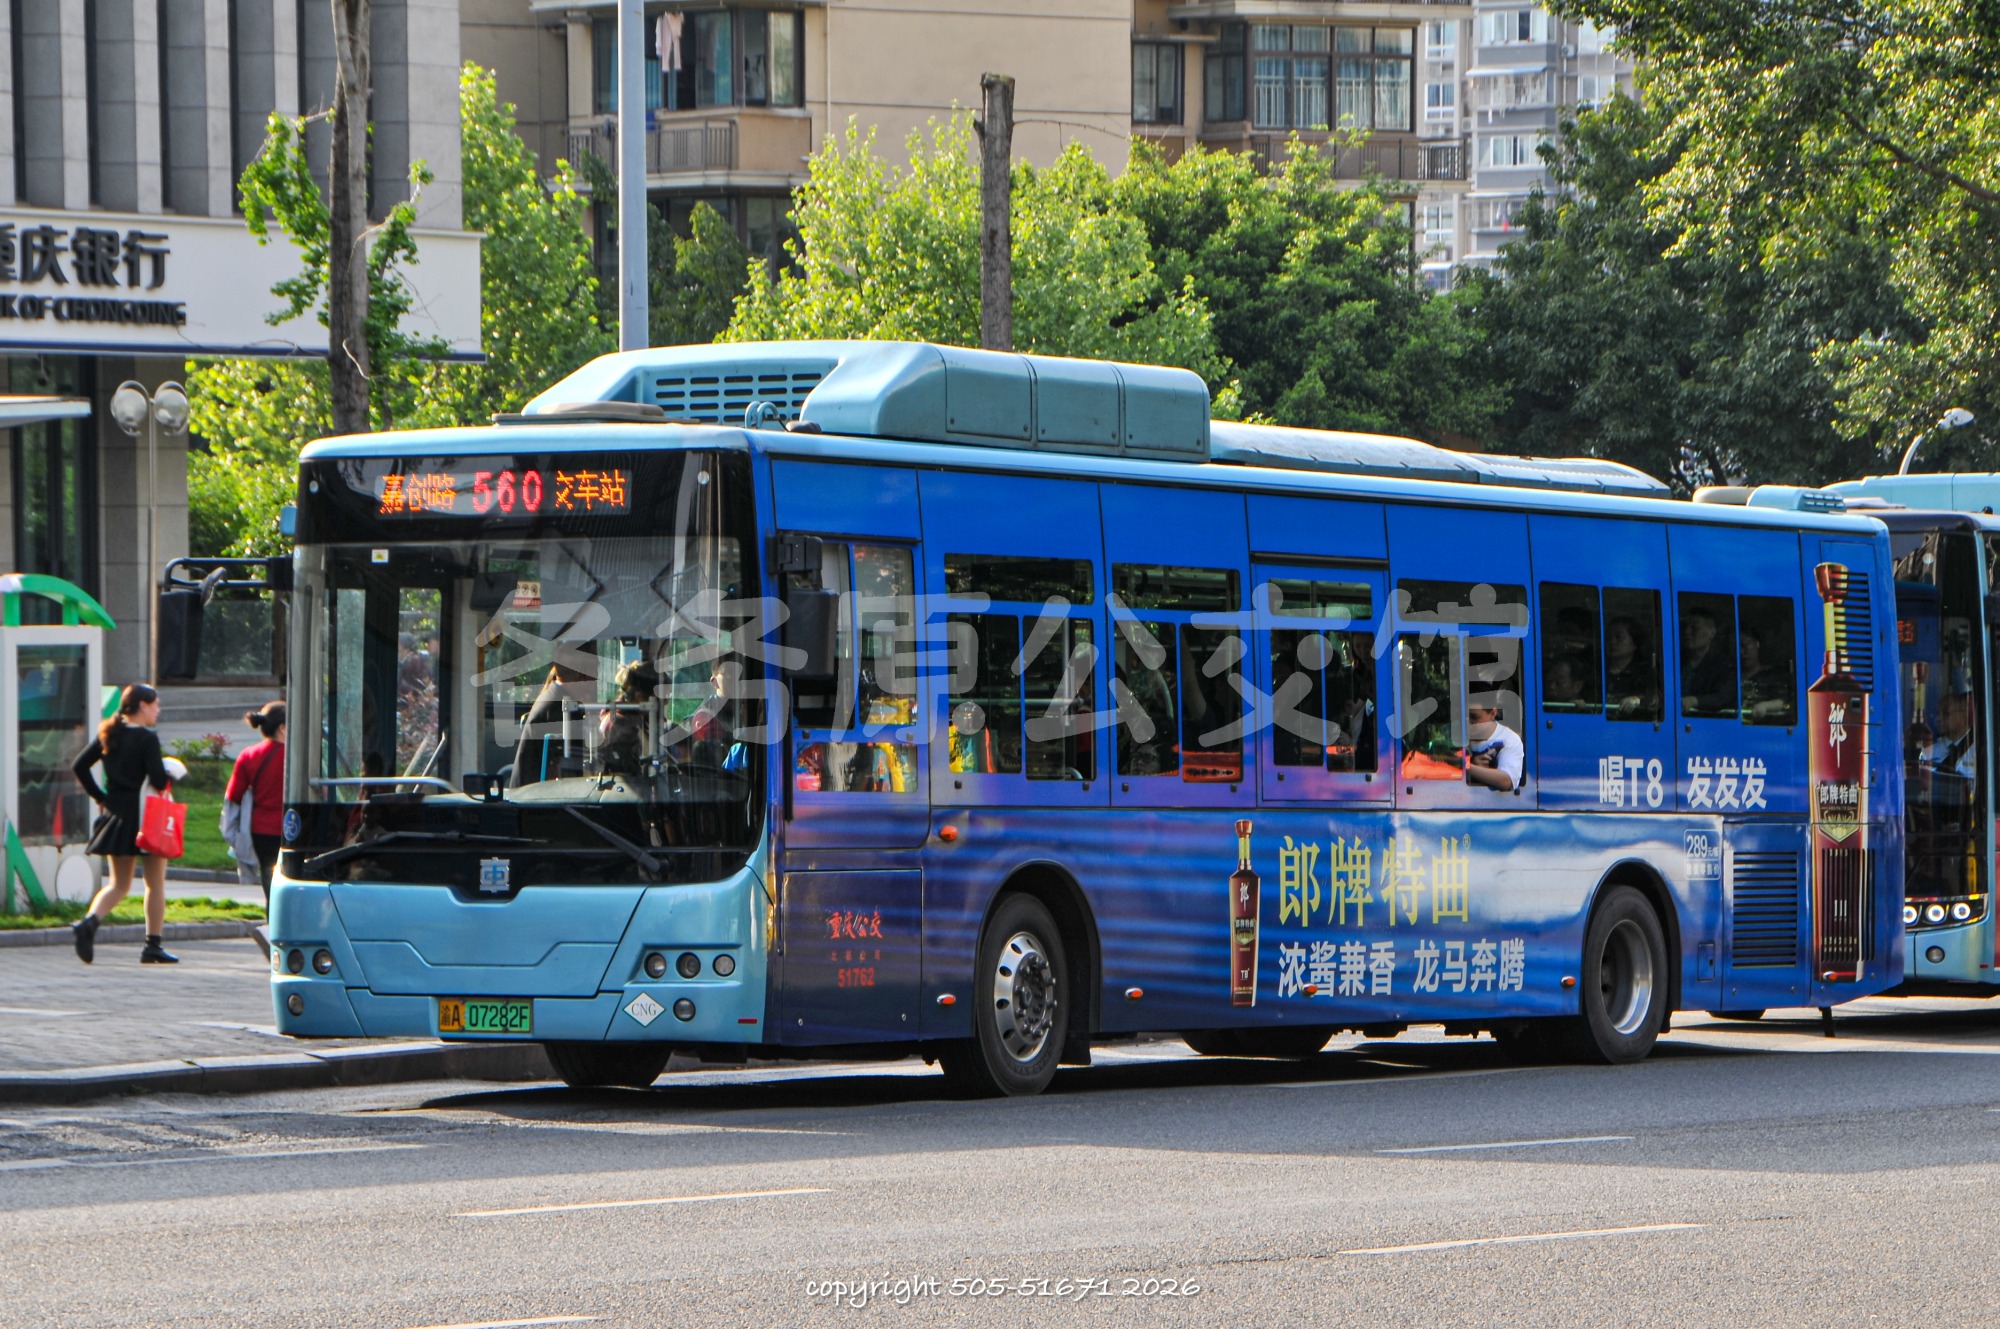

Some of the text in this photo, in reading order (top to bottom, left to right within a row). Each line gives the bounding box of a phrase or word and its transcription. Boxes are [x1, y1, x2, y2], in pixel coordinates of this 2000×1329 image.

[19, 294, 53, 319] OF
[53, 297, 187, 326] CHONGQING
[472, 470, 543, 513] 560
[1598, 755, 1767, 809] 喝T8 发发发
[1278, 835, 1470, 927] 郎牌特曲
[1278, 938, 1525, 998] 浓酱兼香 龙马奔腾
[631, 1002, 657, 1016] CNG
